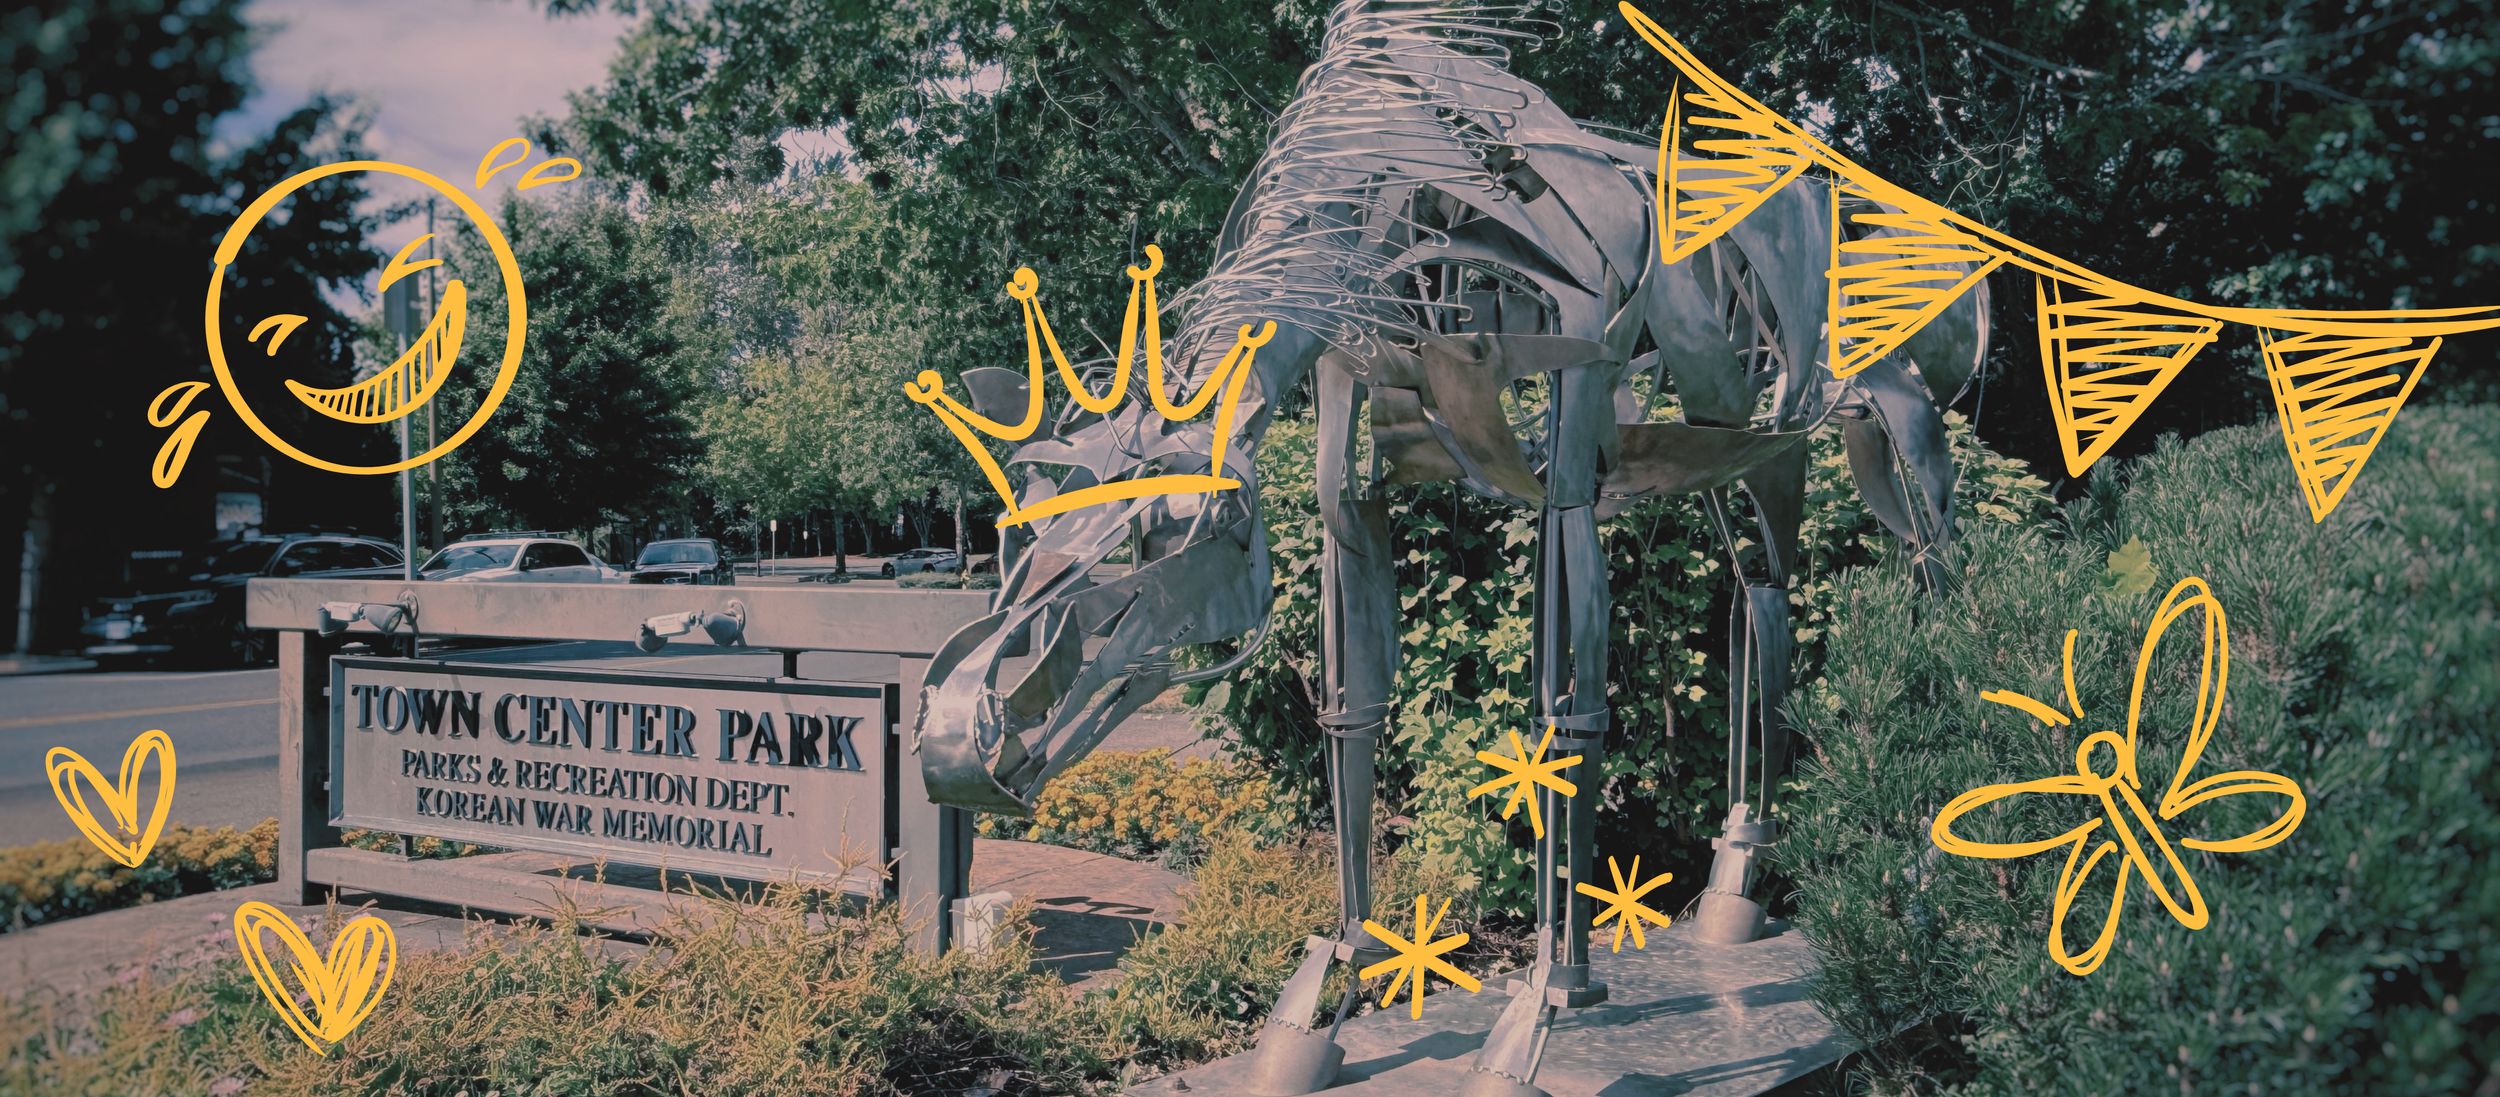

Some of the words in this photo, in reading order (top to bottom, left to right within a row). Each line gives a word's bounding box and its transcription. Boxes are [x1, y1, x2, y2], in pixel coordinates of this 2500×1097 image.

[352, 684, 482, 738] TOWN
[494, 692, 699, 759] CENTER
[715, 708, 867, 773] PARK
[401, 749, 481, 784] PARKS
[487, 757, 509, 787] &
[515, 759, 698, 807] RECREATION
[705, 777, 794, 818] DEPT.
[416, 786, 525, 826] KOREAN
[532, 800, 596, 836] WAR
[601, 807, 773, 857] MEMORIAL
